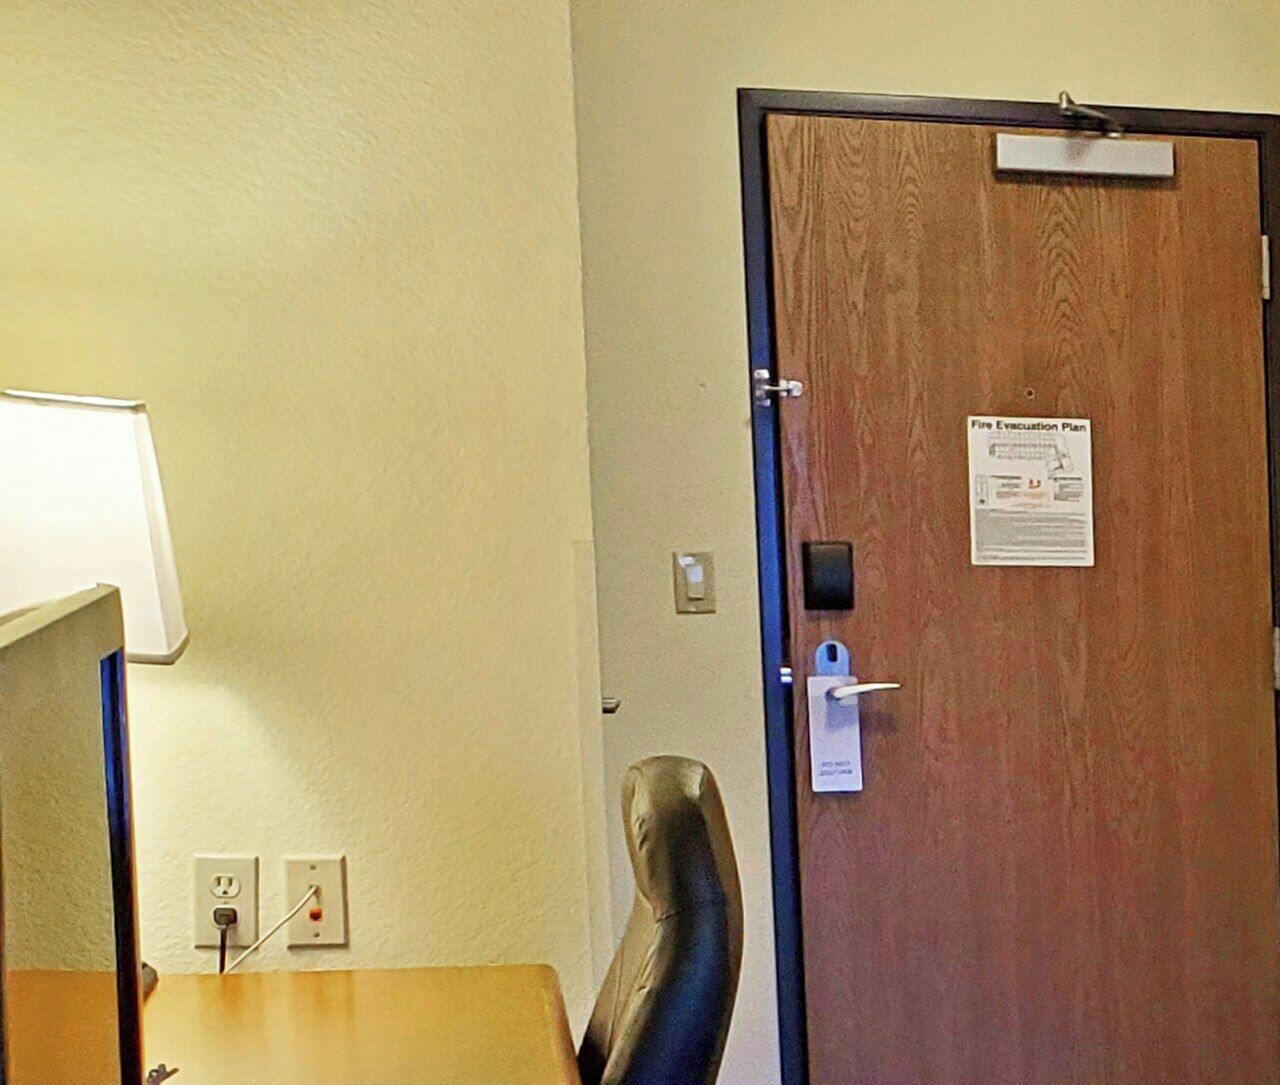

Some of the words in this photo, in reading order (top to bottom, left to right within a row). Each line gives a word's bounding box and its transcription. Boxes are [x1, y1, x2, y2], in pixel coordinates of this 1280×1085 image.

[971, 420, 993, 430] Fire
[996, 420, 1058, 431] Evacuation
[1062, 422, 1087, 432] Plan
